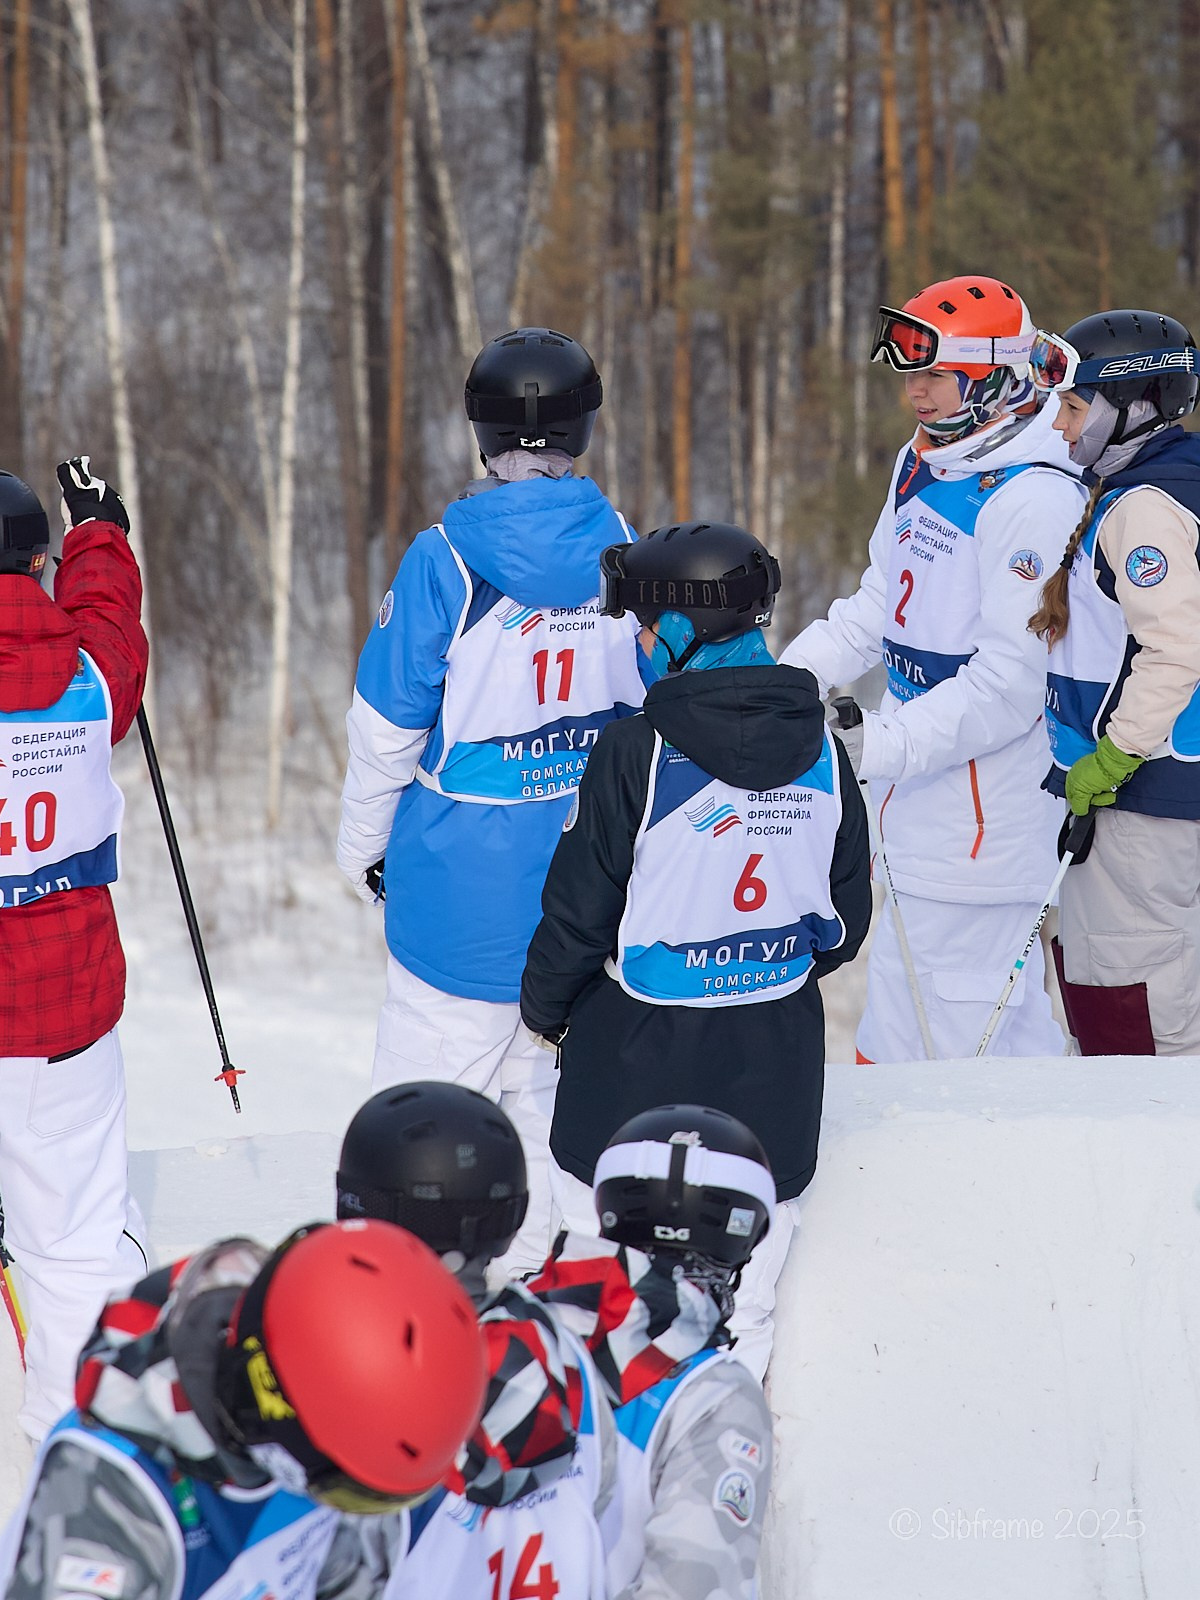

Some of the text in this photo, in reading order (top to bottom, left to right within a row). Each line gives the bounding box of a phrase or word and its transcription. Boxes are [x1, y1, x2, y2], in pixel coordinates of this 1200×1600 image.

[918, 515, 958, 541] ФЕДЕРАЦИЯ
[910, 544, 935, 563] РОССИИ
[913, 530, 953, 556] ФРИСТАЙЛА
[894, 569, 914, 628] 2
[549, 621, 595, 632] РОССИИ
[532, 648, 574, 705] 11
[884, 647, 927, 684] ОГУЛ
[11, 727, 87, 745] ФЕДЕРАЦИЯ
[502, 728, 599, 762] МОГУЛ
[11, 744, 87, 762] ФРИСТАЙЛА
[12, 764, 63, 778] РОССИИ
[747, 792, 813, 803] ФЕДЕРАЦИЯ
[747, 808, 812, 820] ФРИСТАЙЛА
[746, 825, 793, 836] РОССИИ
[733, 853, 768, 912] 6
[685, 935, 798, 969] МОГУЛ
[703, 966, 788, 990] ТОМСКАЯ
[487, 1531, 560, 1600] 14
